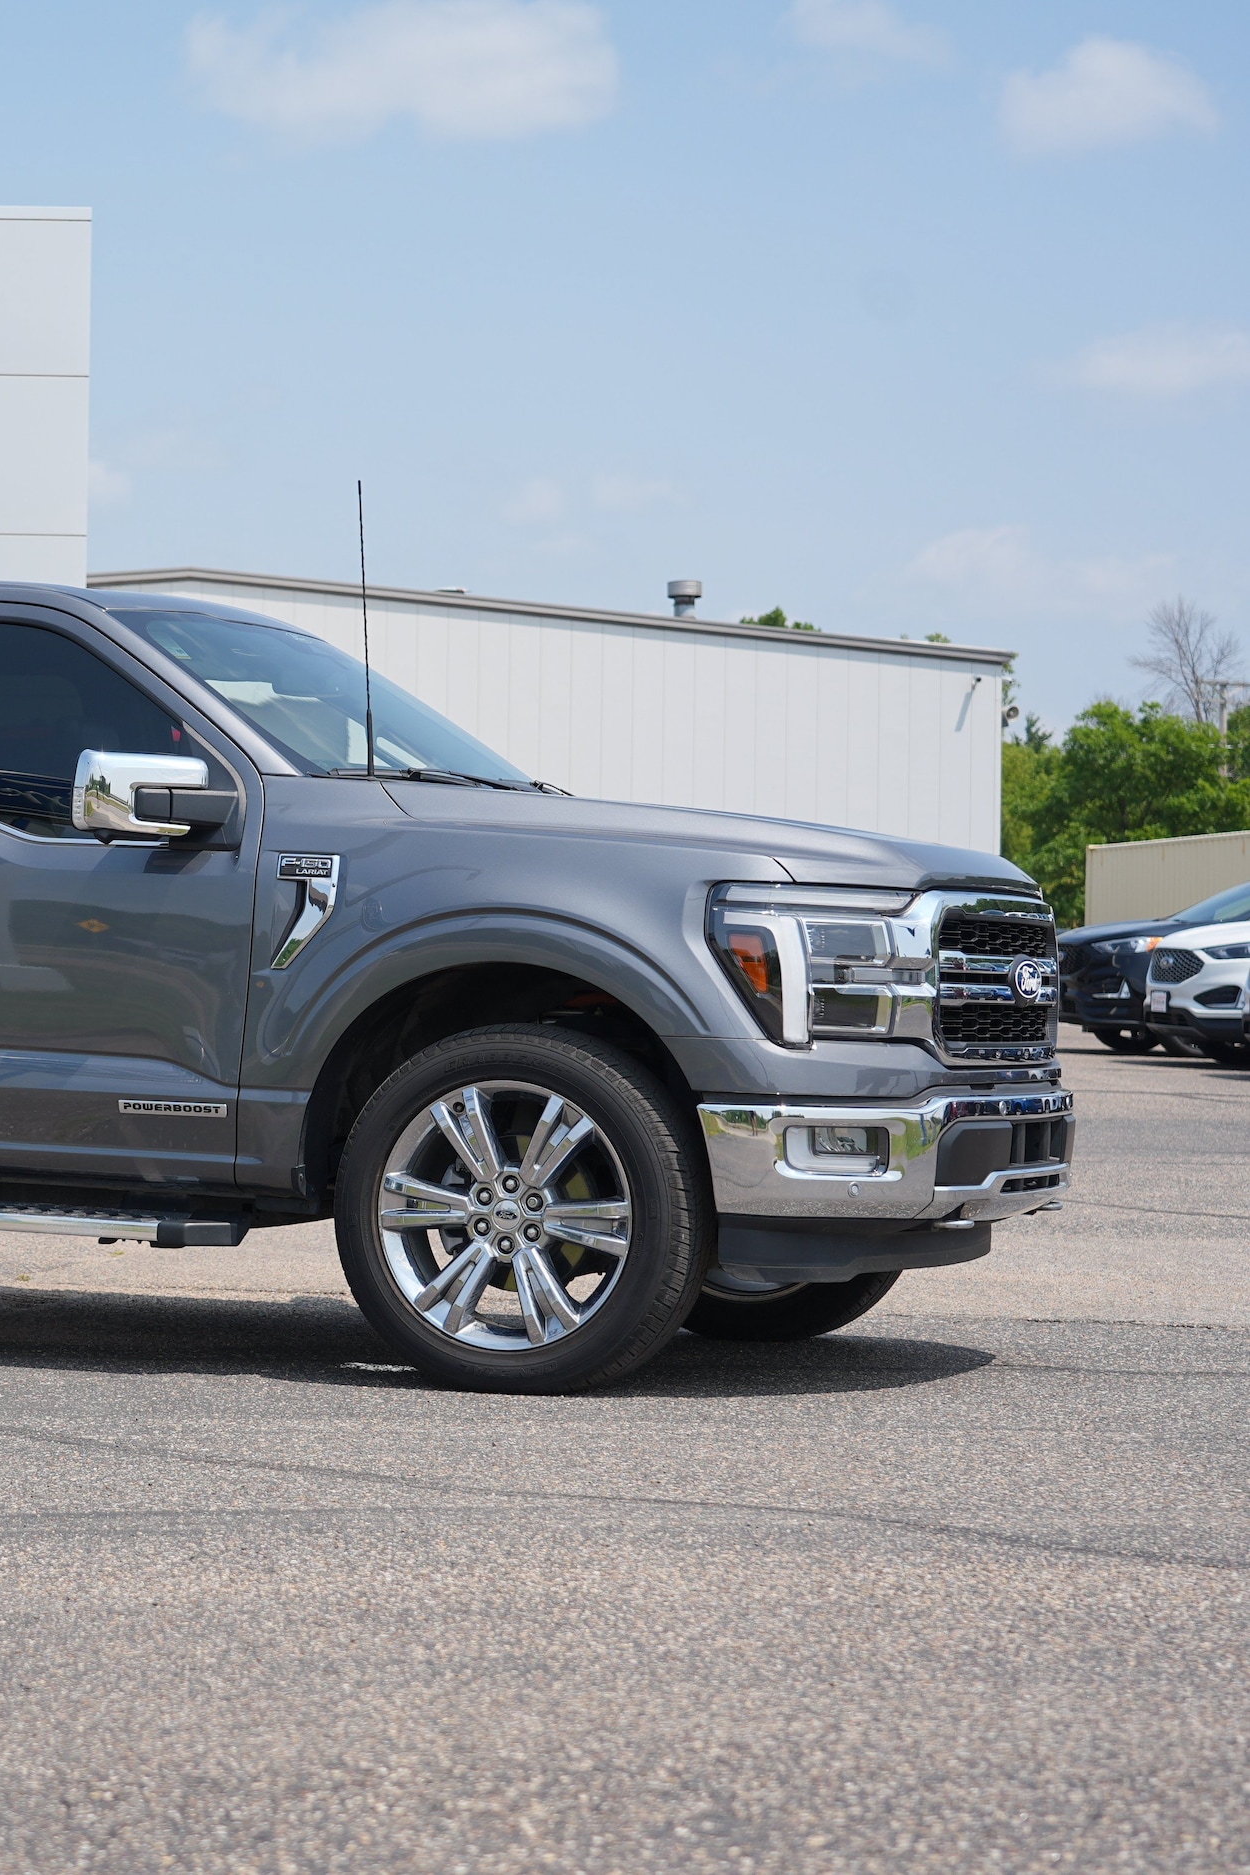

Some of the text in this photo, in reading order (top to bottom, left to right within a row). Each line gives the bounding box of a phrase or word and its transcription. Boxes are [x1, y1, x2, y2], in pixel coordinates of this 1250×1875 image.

[281, 857, 332, 869] F-150
[295, 868, 329, 876] LARIAT
[1019, 965, 1041, 992] Ford
[123, 1102, 221, 1114] POWERBOOST
